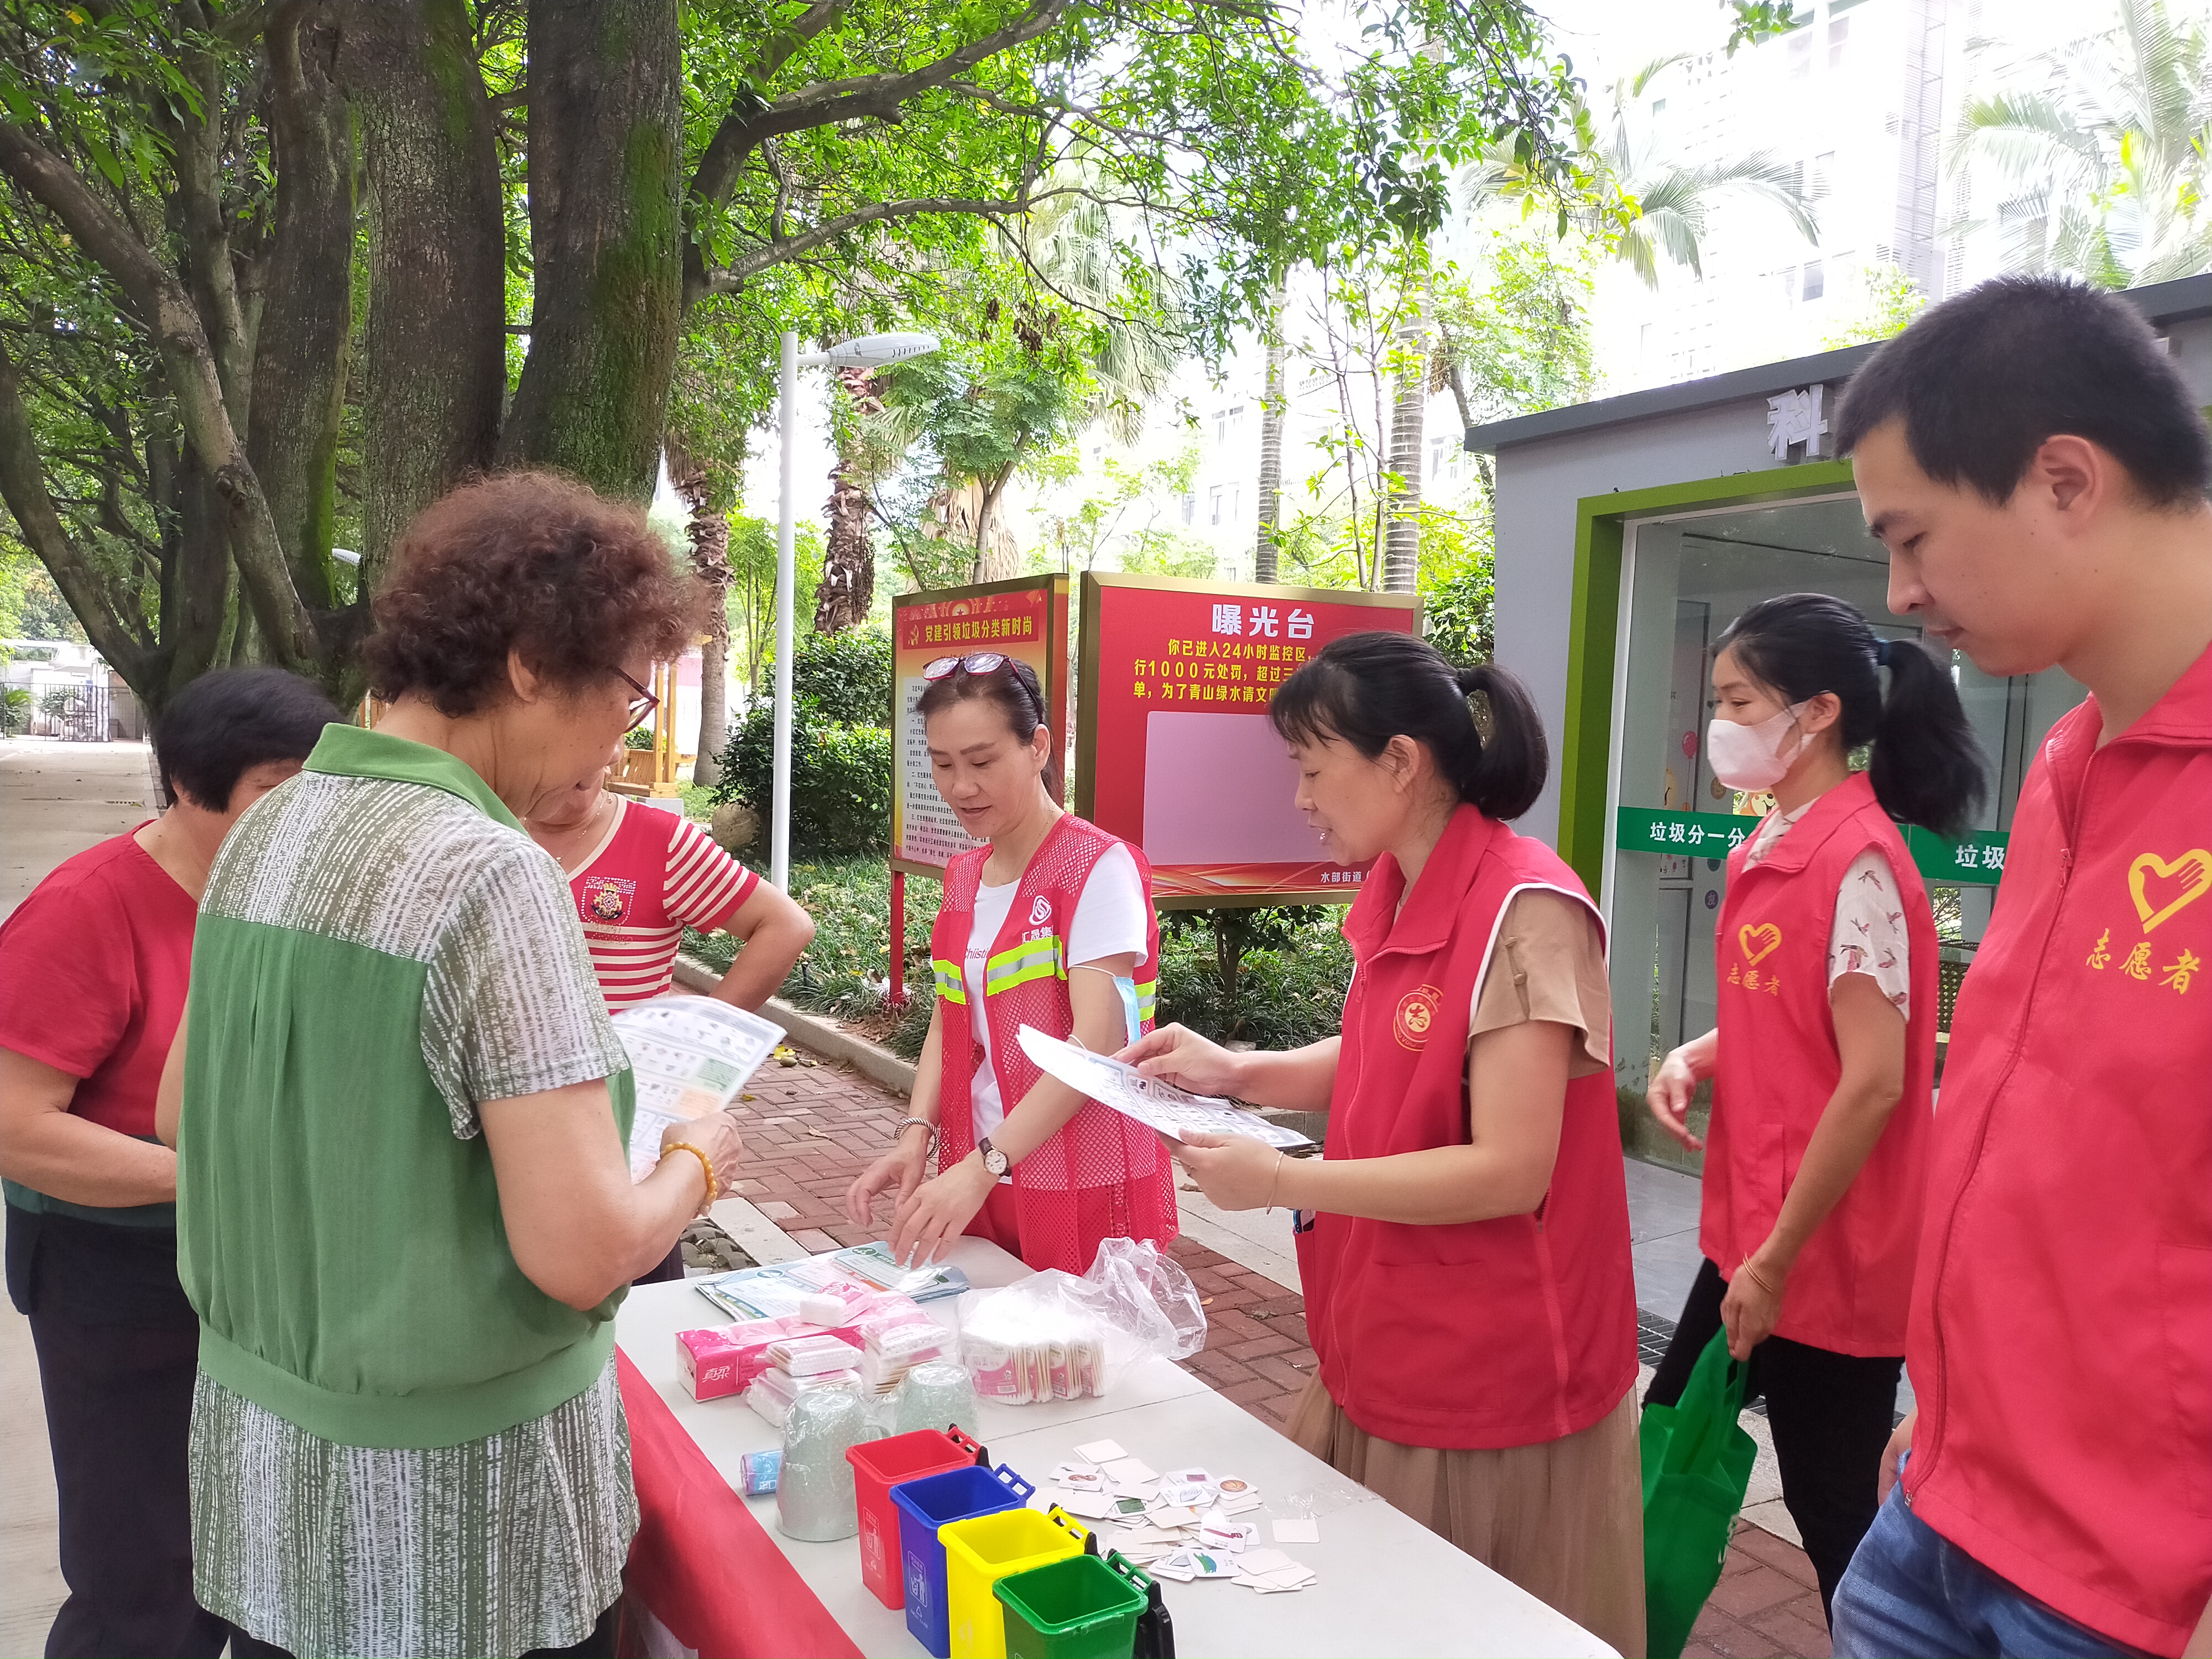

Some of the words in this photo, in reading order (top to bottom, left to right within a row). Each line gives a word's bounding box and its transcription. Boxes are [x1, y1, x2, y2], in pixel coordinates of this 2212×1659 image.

[1766, 383, 1828, 461] 科
[925, 615, 1032, 643] 党建引领垃圾分类新时尚
[1211, 603, 1315, 639] 曝光台
[1649, 821, 1746, 848] 垃圾分一分
[1955, 844, 2005, 871] 垃圾
[1021, 925, 1054, 945] 汇晟集
[2085, 927, 2200, 995] 志愿者
[1726, 962, 1780, 997] 志愿者
